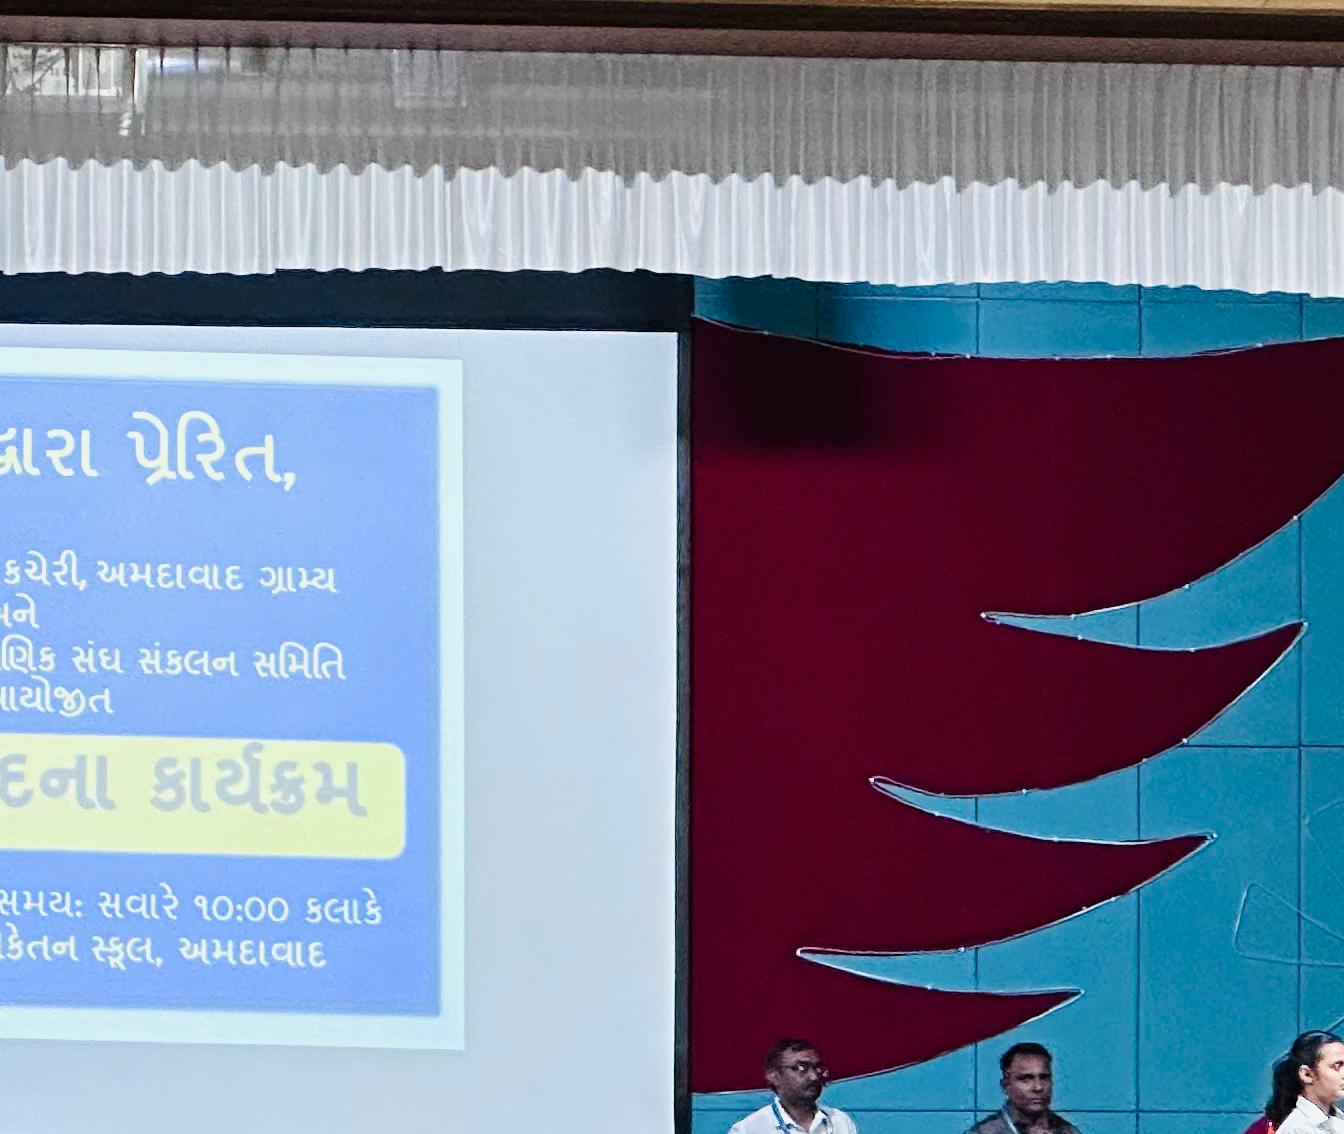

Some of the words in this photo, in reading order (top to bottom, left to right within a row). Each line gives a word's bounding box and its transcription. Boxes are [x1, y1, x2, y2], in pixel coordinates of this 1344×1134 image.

[127, 411, 296, 491] પ્રેરિત,
[4, 550, 87, 591] કચેરી,
[97, 561, 243, 590] અમદાવાદ
[260, 567, 338, 594] ગ્રામ્ય
[72, 640, 124, 673] સંઘ
[138, 642, 240, 676] સંકલન
[254, 642, 347, 680] સમિતિ
[150, 742, 368, 817] કાર્યક્રમ
[98, 882, 179, 920] સવારે
[306, 888, 382, 925] કલાકે
[179, 938, 326, 968] અમદાવાદ
